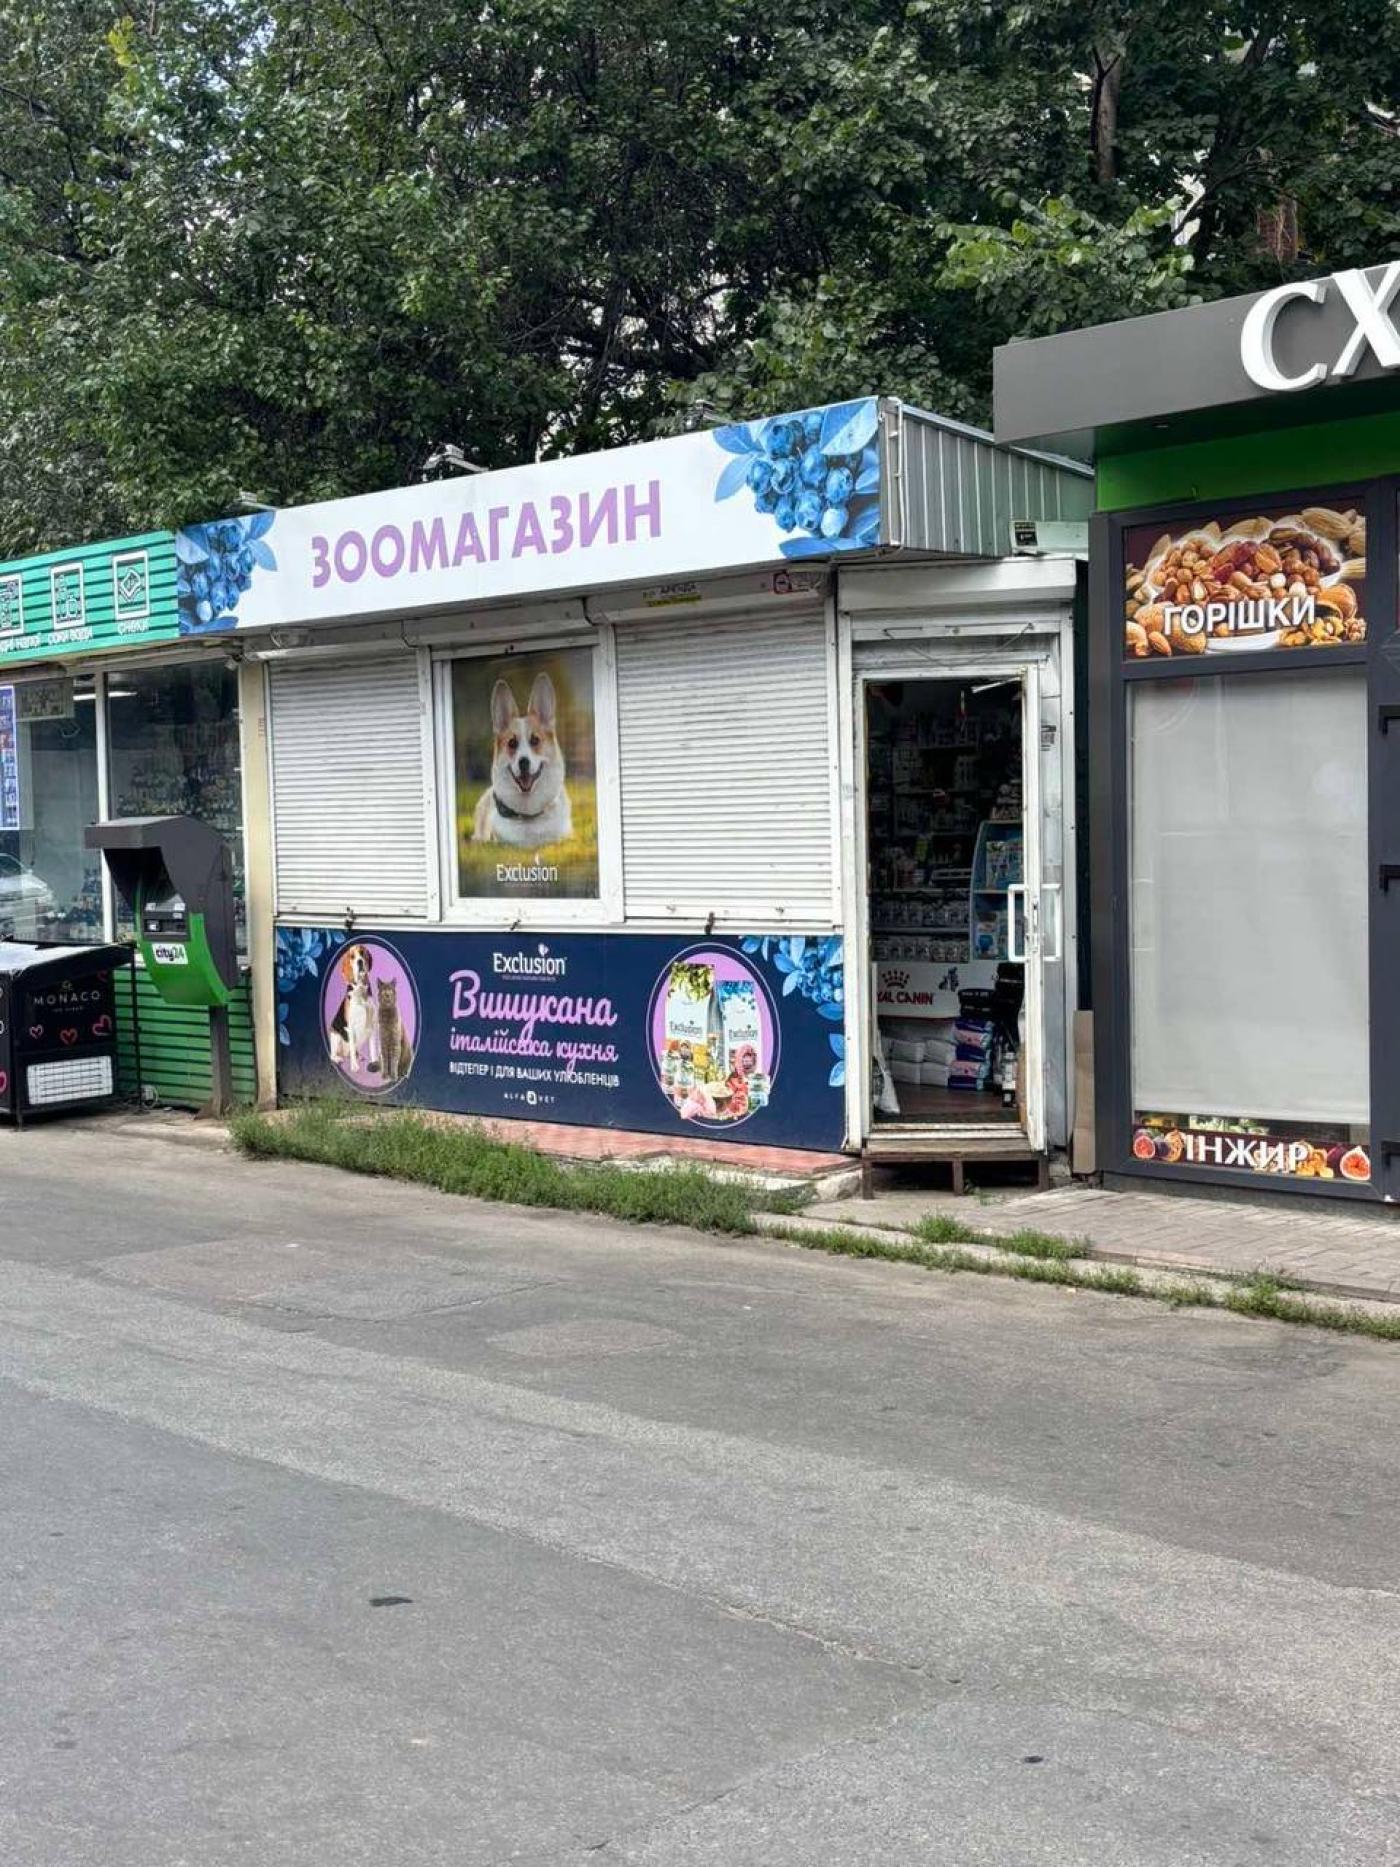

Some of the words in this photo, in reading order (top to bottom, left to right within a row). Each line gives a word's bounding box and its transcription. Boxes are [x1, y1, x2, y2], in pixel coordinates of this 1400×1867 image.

[311, 480, 662, 588] ЗООМАГАЗИН
[1162, 594, 1316, 635] ГОРІШКИ
[496, 854, 559, 882] Exclusion
[155, 945, 185, 961] city24
[493, 945, 566, 975] Exclusion
[33, 990, 101, 1006] MONACO
[449, 969, 618, 1040] Вишукана
[877, 991, 895, 1004] YAL
[896, 992, 934, 1006] CANIN
[556, 1043, 619, 1073] кухня
[449, 1061, 489, 1077] ВІДТЕПЕР
[495, 1066, 515, 1079] ДЛЯ
[516, 1068, 553, 1082] ВАШИХ
[554, 1071, 621, 1088] УЛЮБЛЕНЦІВ
[1185, 1133, 1310, 1173] ІНЖИР
